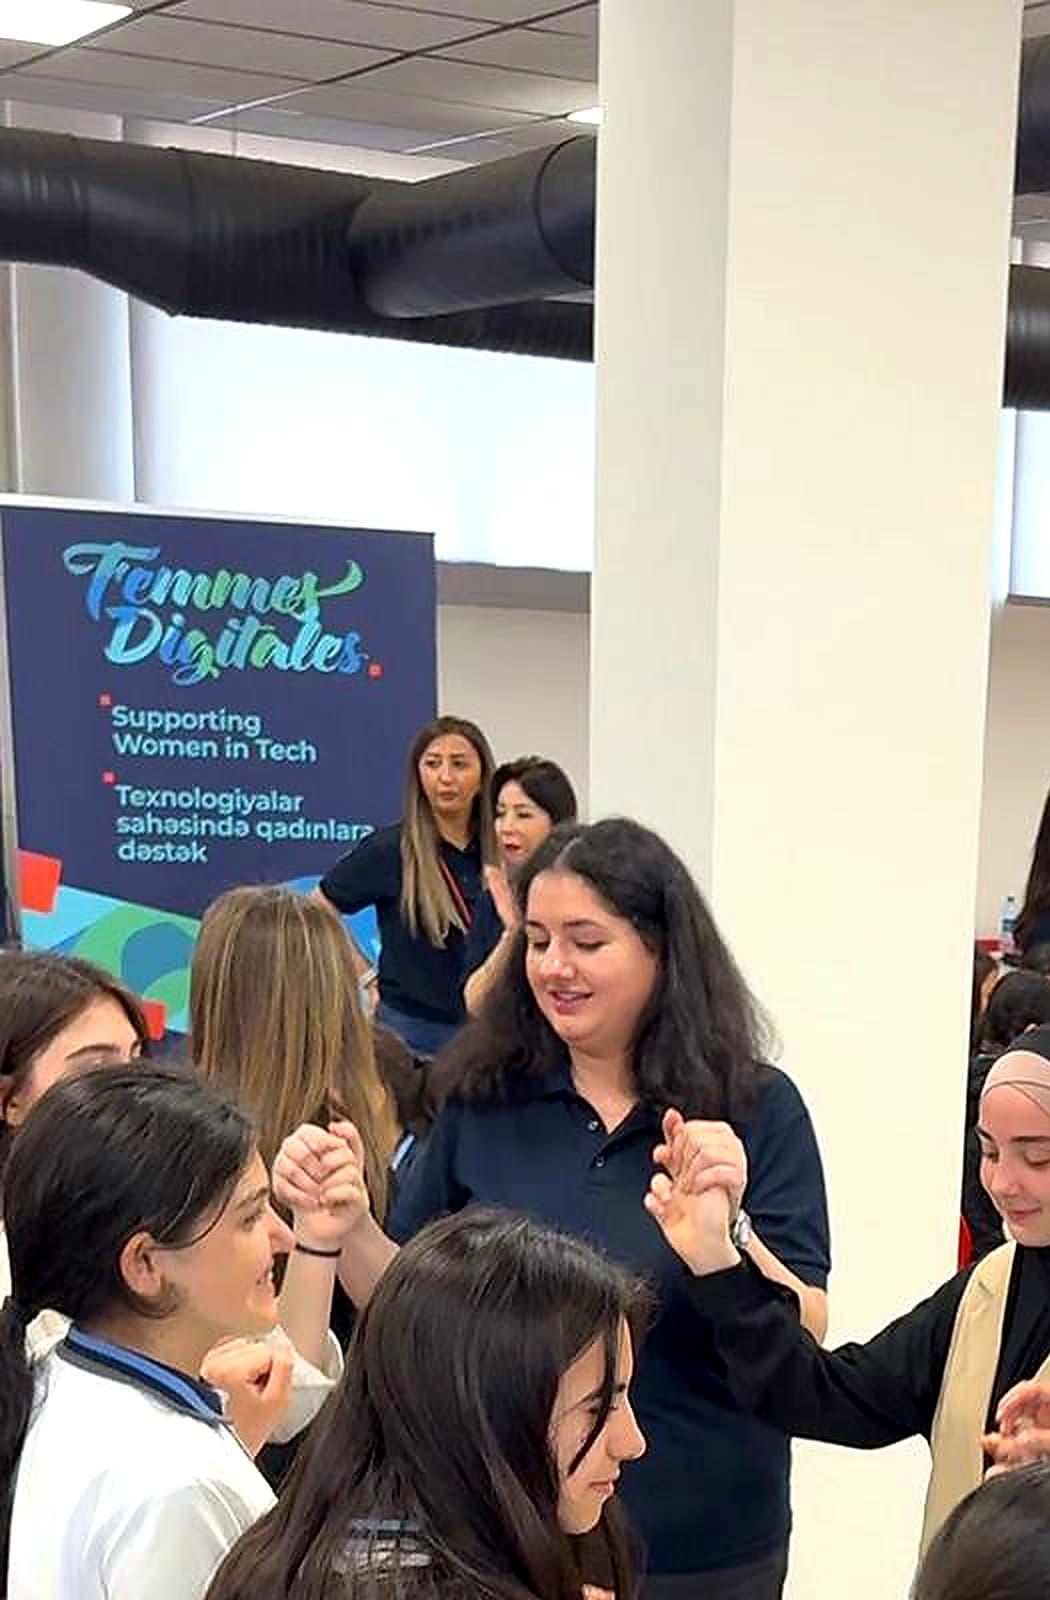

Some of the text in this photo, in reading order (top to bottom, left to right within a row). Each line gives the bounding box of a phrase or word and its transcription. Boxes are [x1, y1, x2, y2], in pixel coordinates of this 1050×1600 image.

[63, 541, 364, 622] Femmes
[111, 704, 261, 737] Supporting
[112, 733, 318, 763] Women in Tech
[114, 784, 305, 815] Texnologiyalar
[117, 838, 209, 863] dəstək
